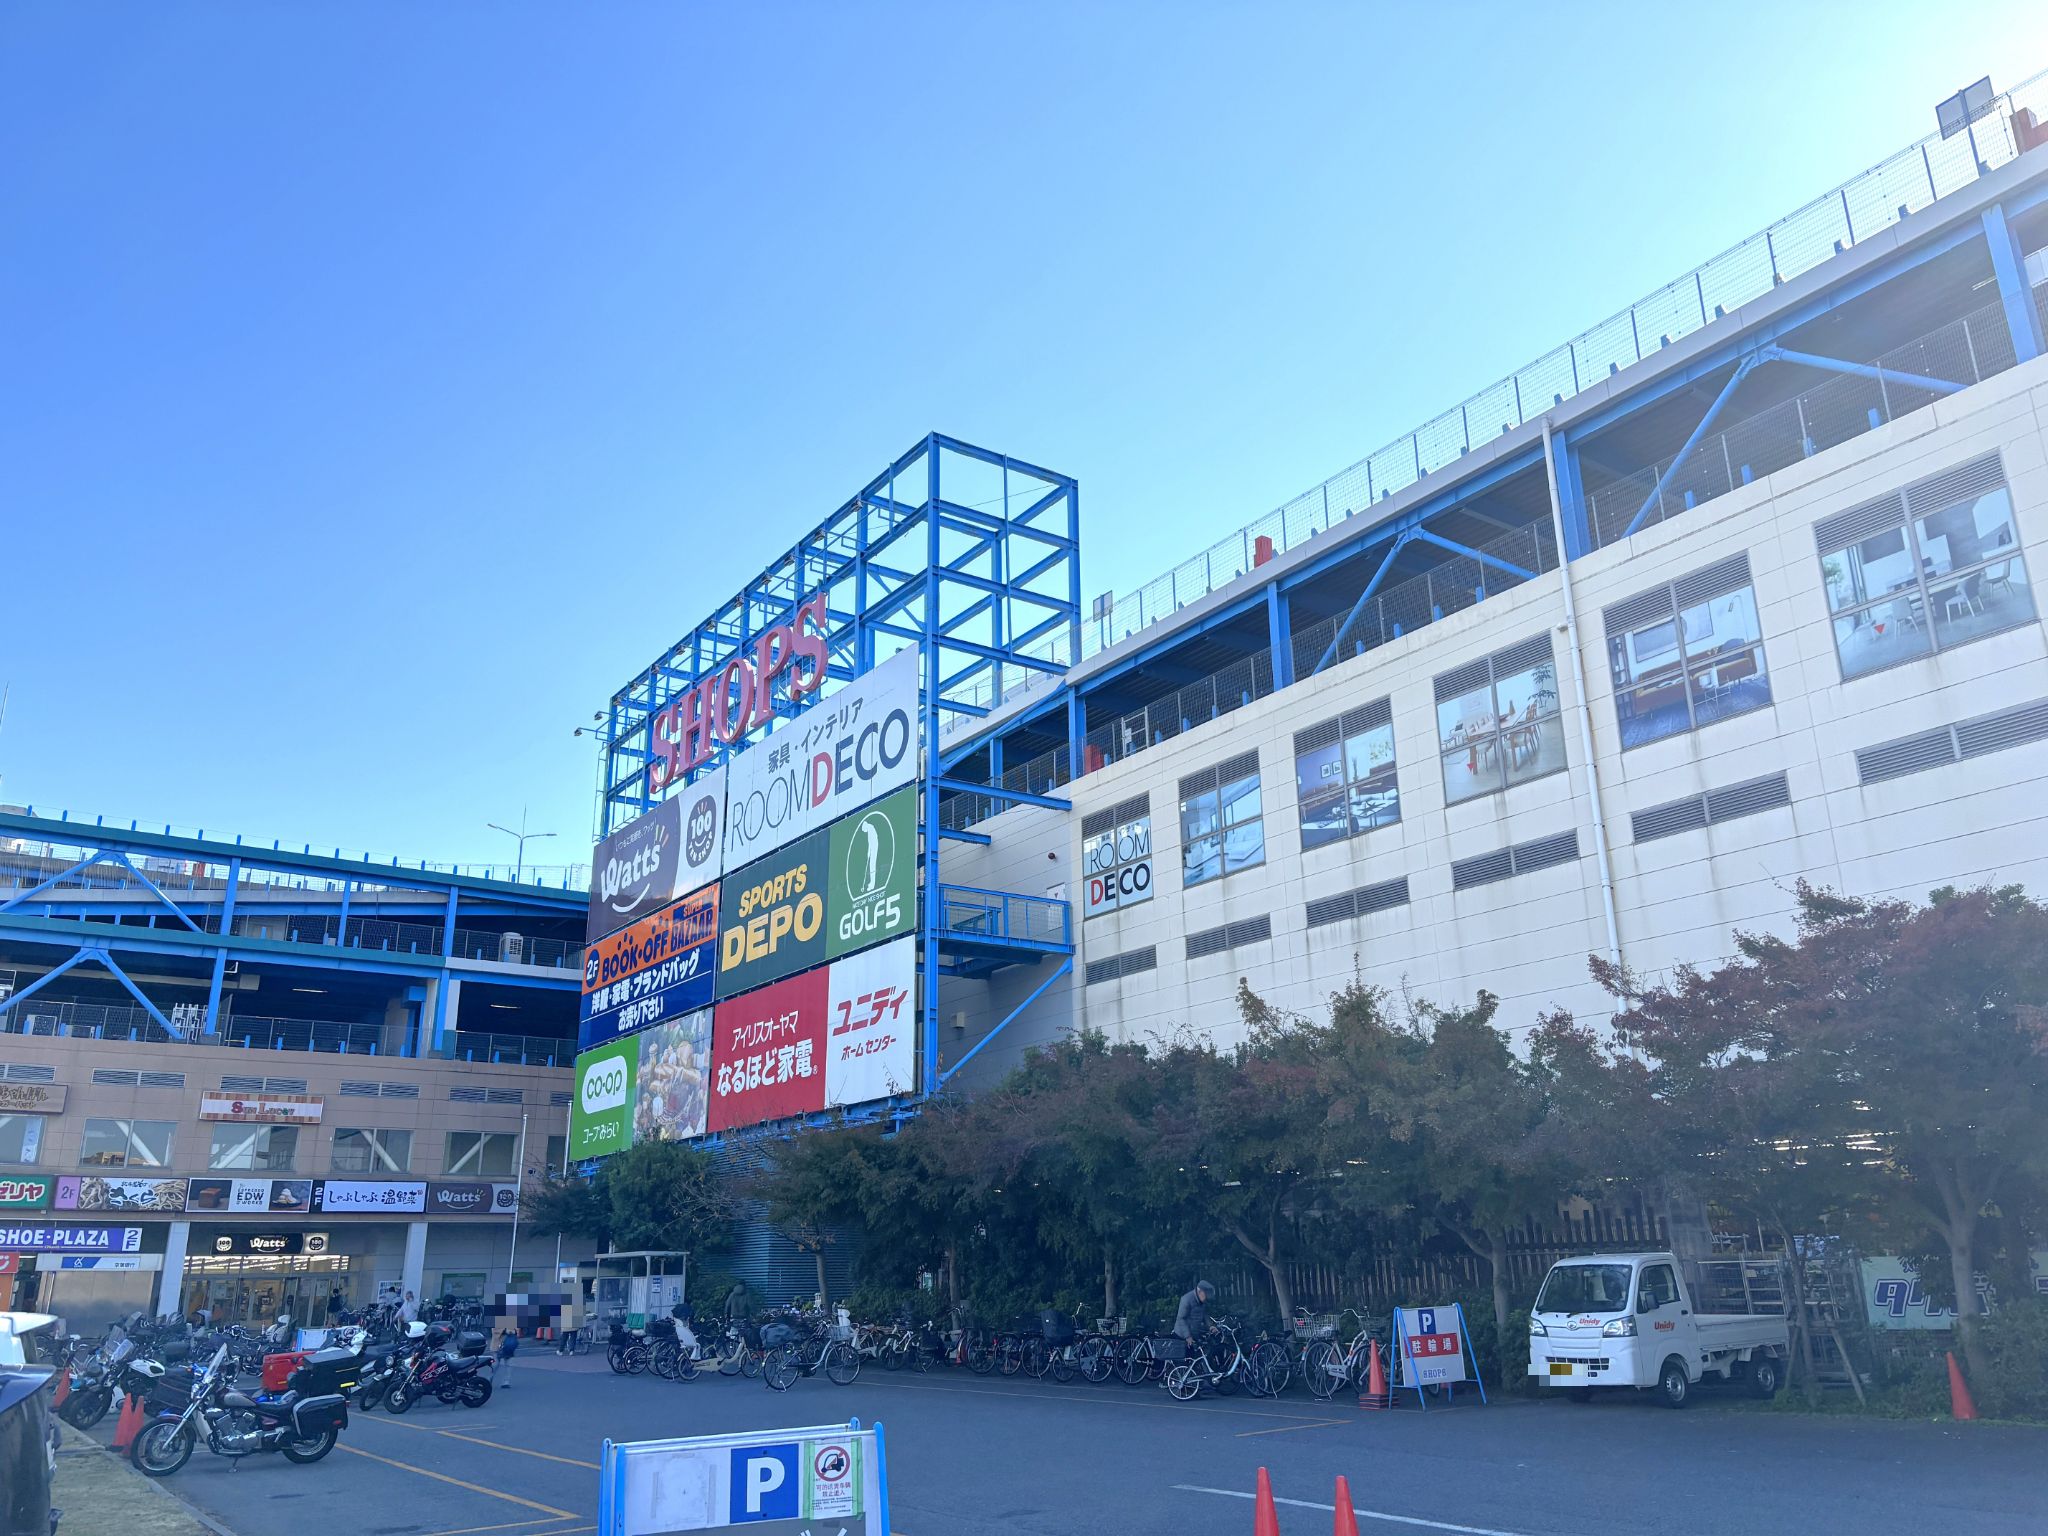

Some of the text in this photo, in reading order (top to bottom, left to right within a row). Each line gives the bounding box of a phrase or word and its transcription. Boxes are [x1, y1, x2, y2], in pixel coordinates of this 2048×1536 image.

[650, 592, 828, 794] SHOPS
[767, 697, 864, 774] 家具・インテリア
[691, 810, 712, 839] 100
[1090, 828, 1150, 873] ROOM
[600, 844, 661, 903] Watts
[1091, 863, 1150, 906] DECO
[738, 863, 808, 918] SPORTS
[670, 908, 714, 952] BAZAAR
[721, 893, 823, 972] DEPO
[586, 959, 599, 981] 2F
[618, 995, 664, 1031] お売り下さい
[832, 986, 909, 1036] ユニディ
[732, 1010, 799, 1051] アイリスオーヤマ
[841, 1035, 897, 1061] ホームセンター
[582, 1121, 620, 1144] コープみらい
[61, 1186, 75, 1199] 2F
[236, 1192, 264, 1201] EDW
[437, 1189, 482, 1203] Watts
[249, 1237, 286, 1249] Watts
[1421, 1313, 1432, 1333] P
[1579, 1318, 1601, 1326] Unidy
[1654, 1321, 1676, 1330] Unidy
[1412, 1337, 1452, 1354] 駐輪場
[1423, 1368, 1447, 1379] SHOPS
[746, 1456, 786, 1513] P
